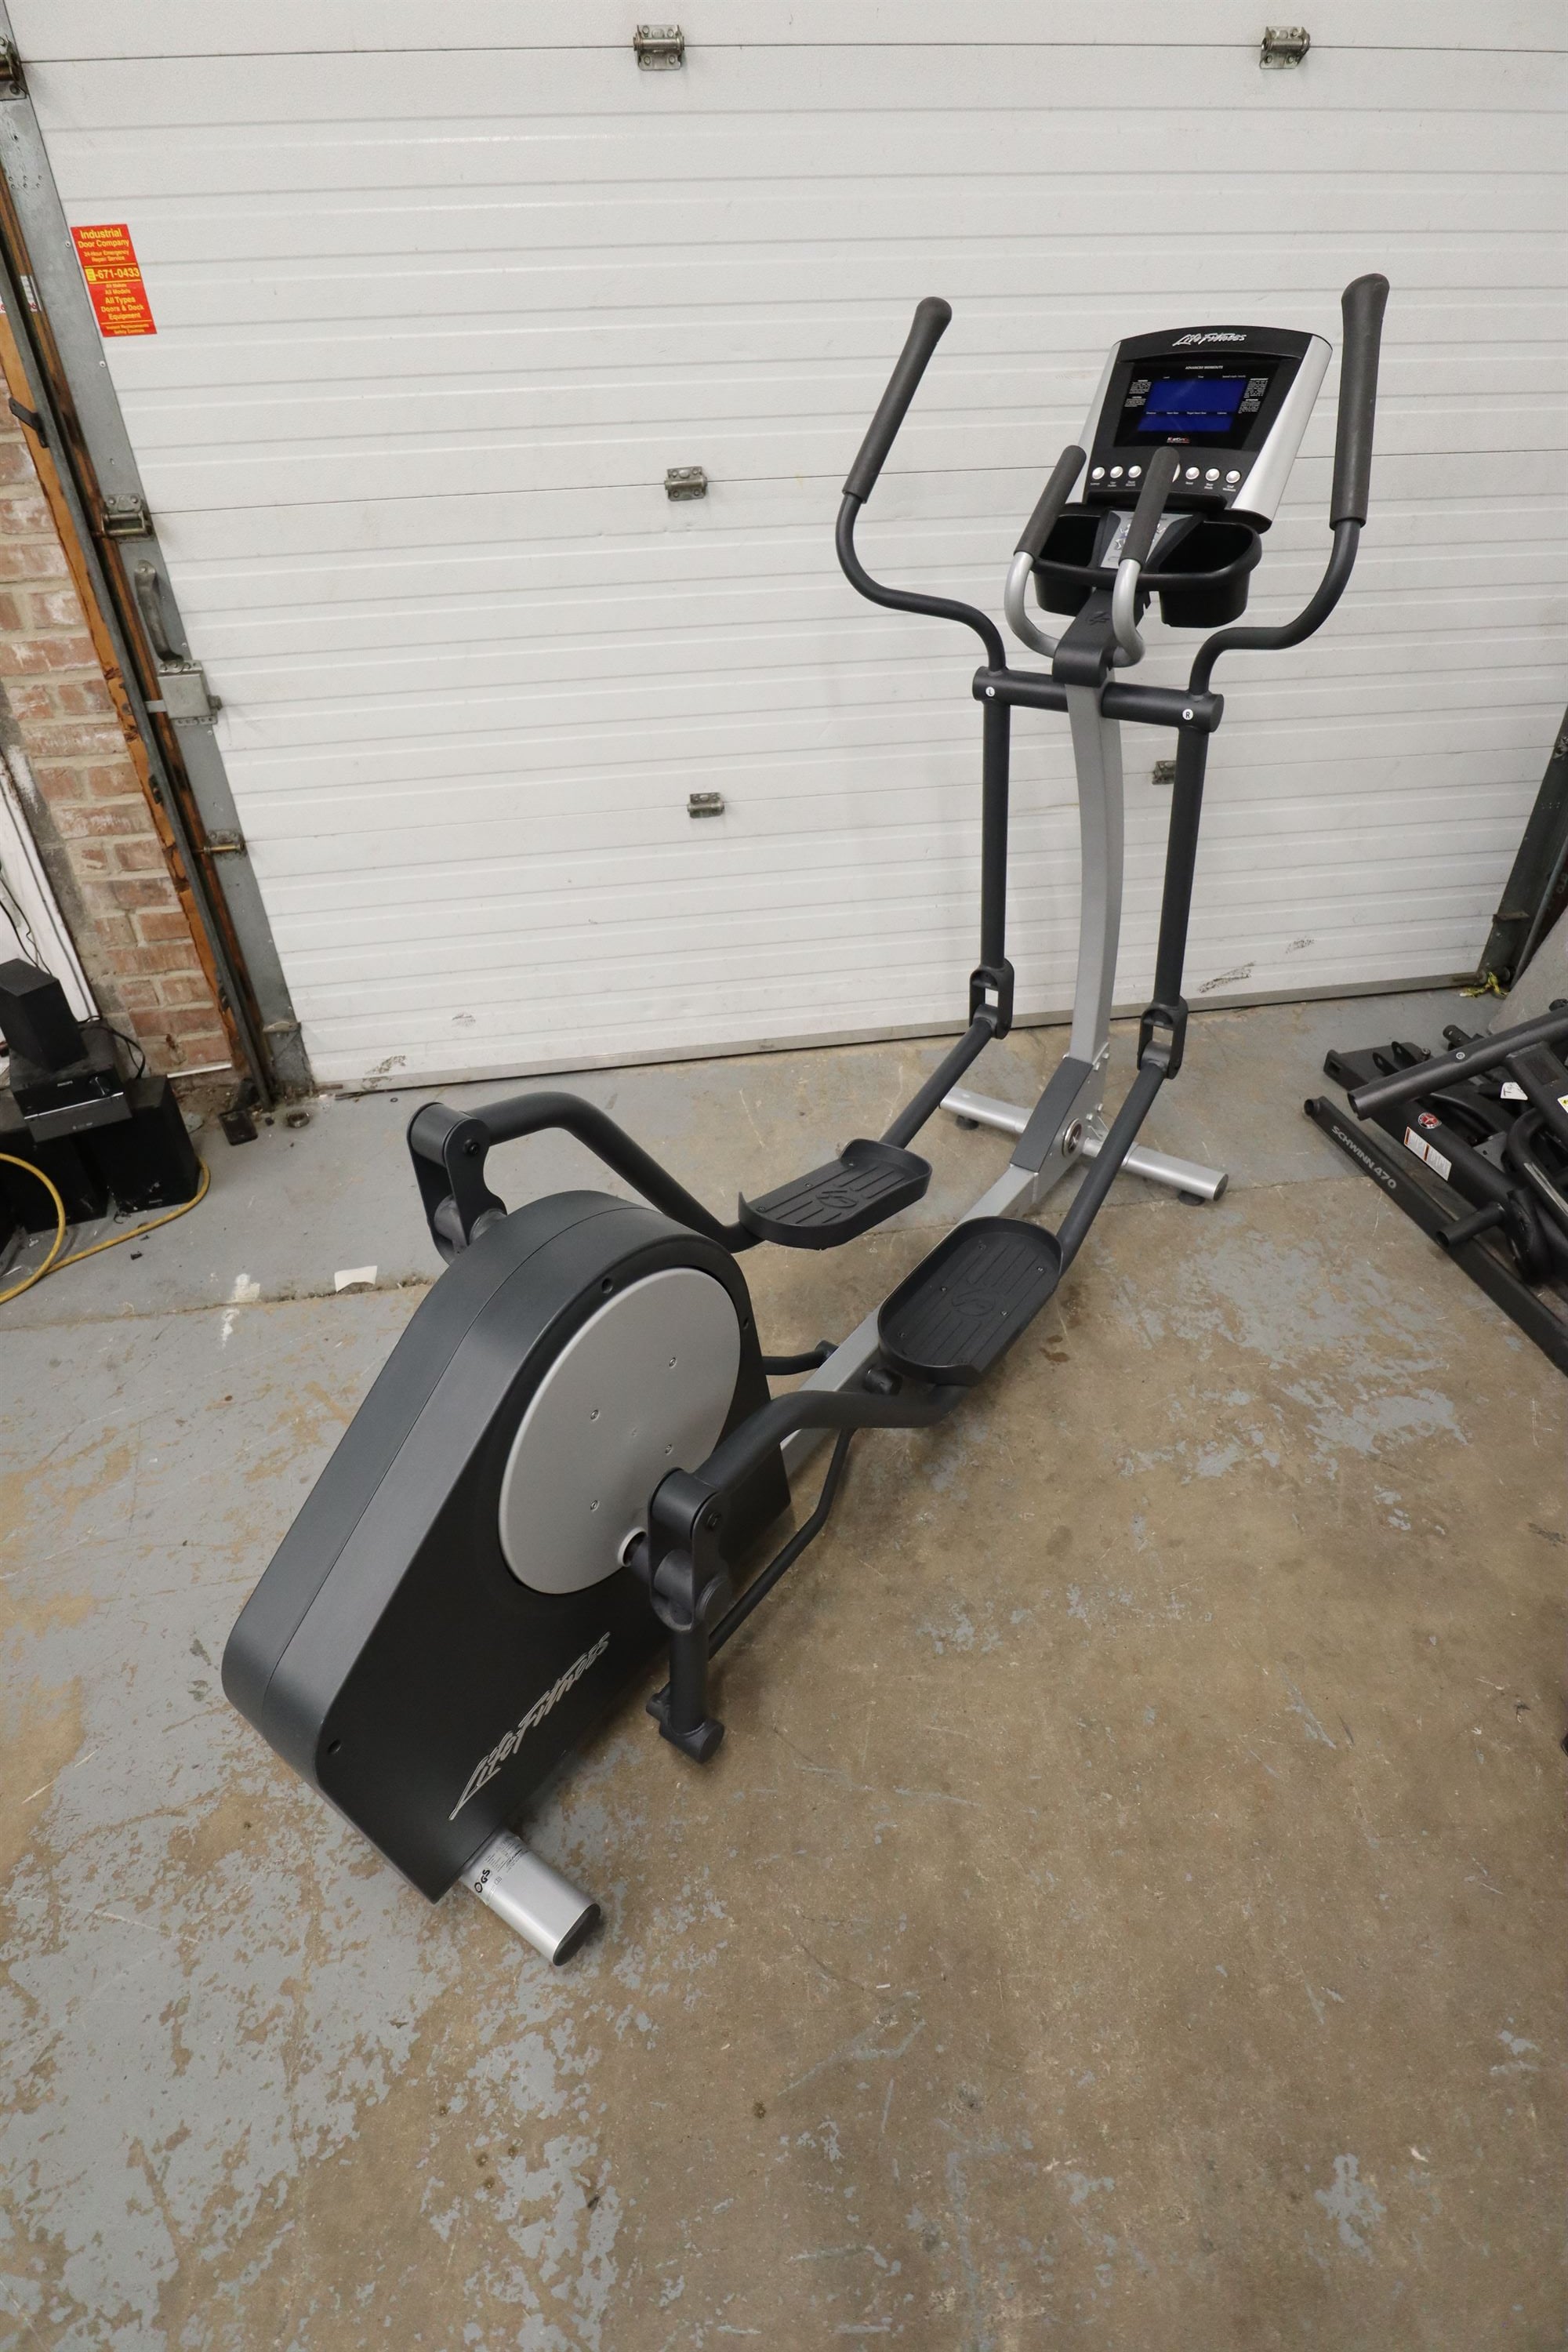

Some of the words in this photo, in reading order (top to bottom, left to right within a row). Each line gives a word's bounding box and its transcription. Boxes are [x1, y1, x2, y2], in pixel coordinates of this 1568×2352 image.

[80, 227, 122, 239] Industrial
[114, 296, 136, 305] Types
[1331, 1125, 1375, 1169] SCHWINN
[1374, 1167, 1397, 1189] 470
